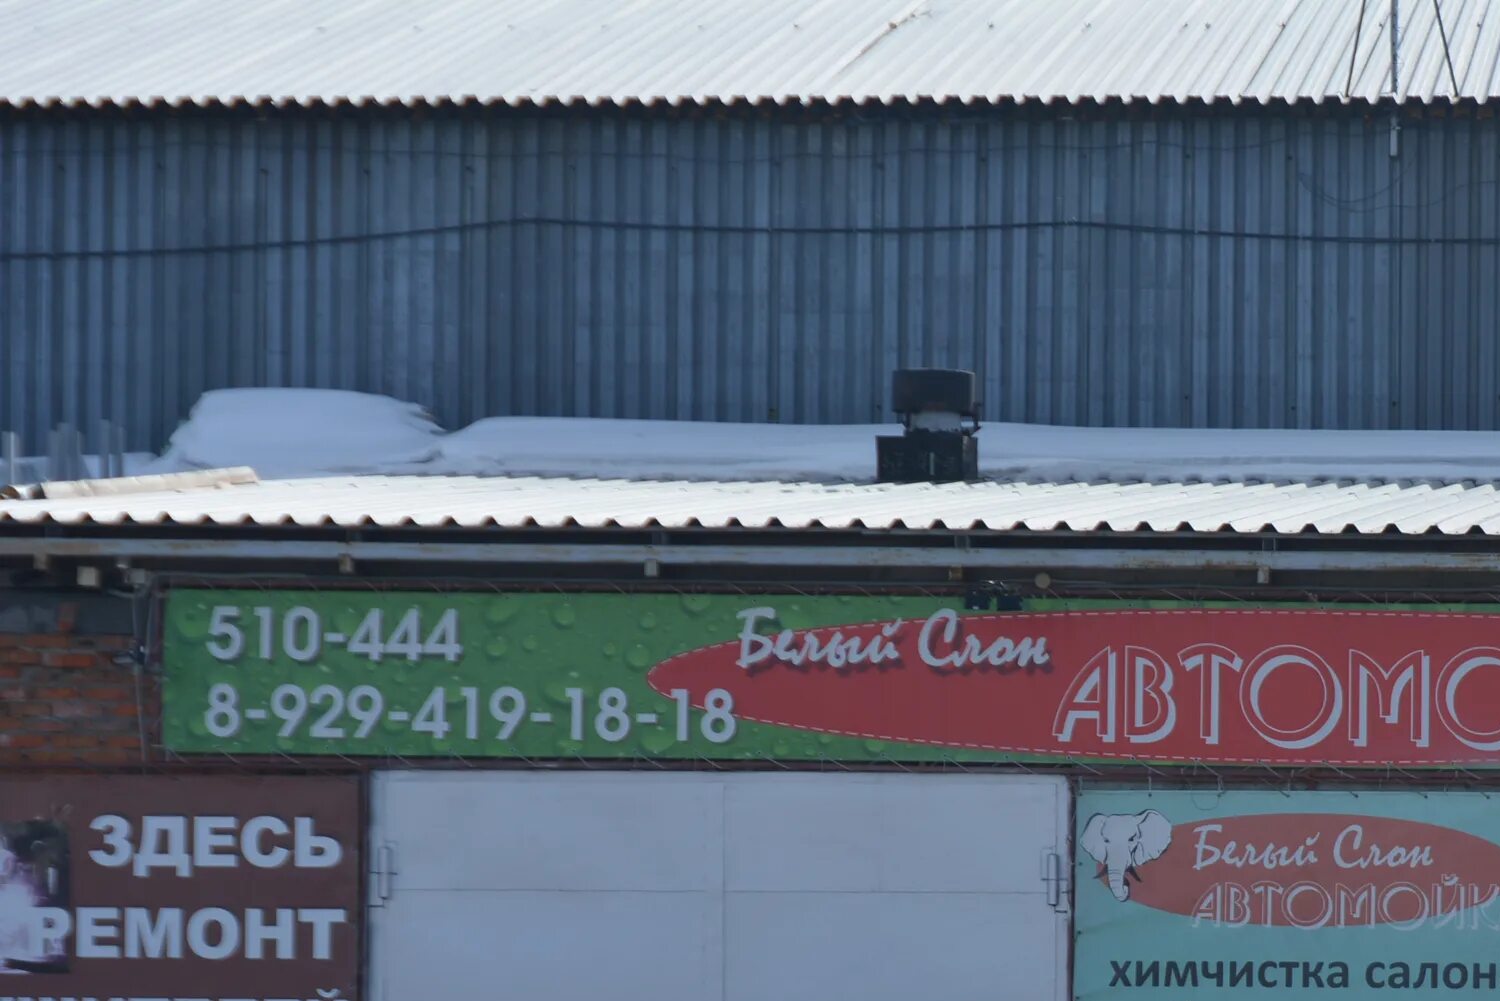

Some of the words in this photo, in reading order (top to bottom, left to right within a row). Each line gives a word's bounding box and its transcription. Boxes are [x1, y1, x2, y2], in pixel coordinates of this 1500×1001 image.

[206, 605, 463, 663] 510-444
[736, 607, 903, 669] Белый
[917, 607, 1050, 668] Слон
[204, 684, 737, 744] 8-929-419-18-18
[88, 815, 343, 878] ЗДЕСЬ
[1192, 824, 1320, 871] Белый
[1333, 824, 1434, 869] Слон
[32, 907, 346, 960] РЕМОНТ
[1109, 960, 1349, 989] химчистка
